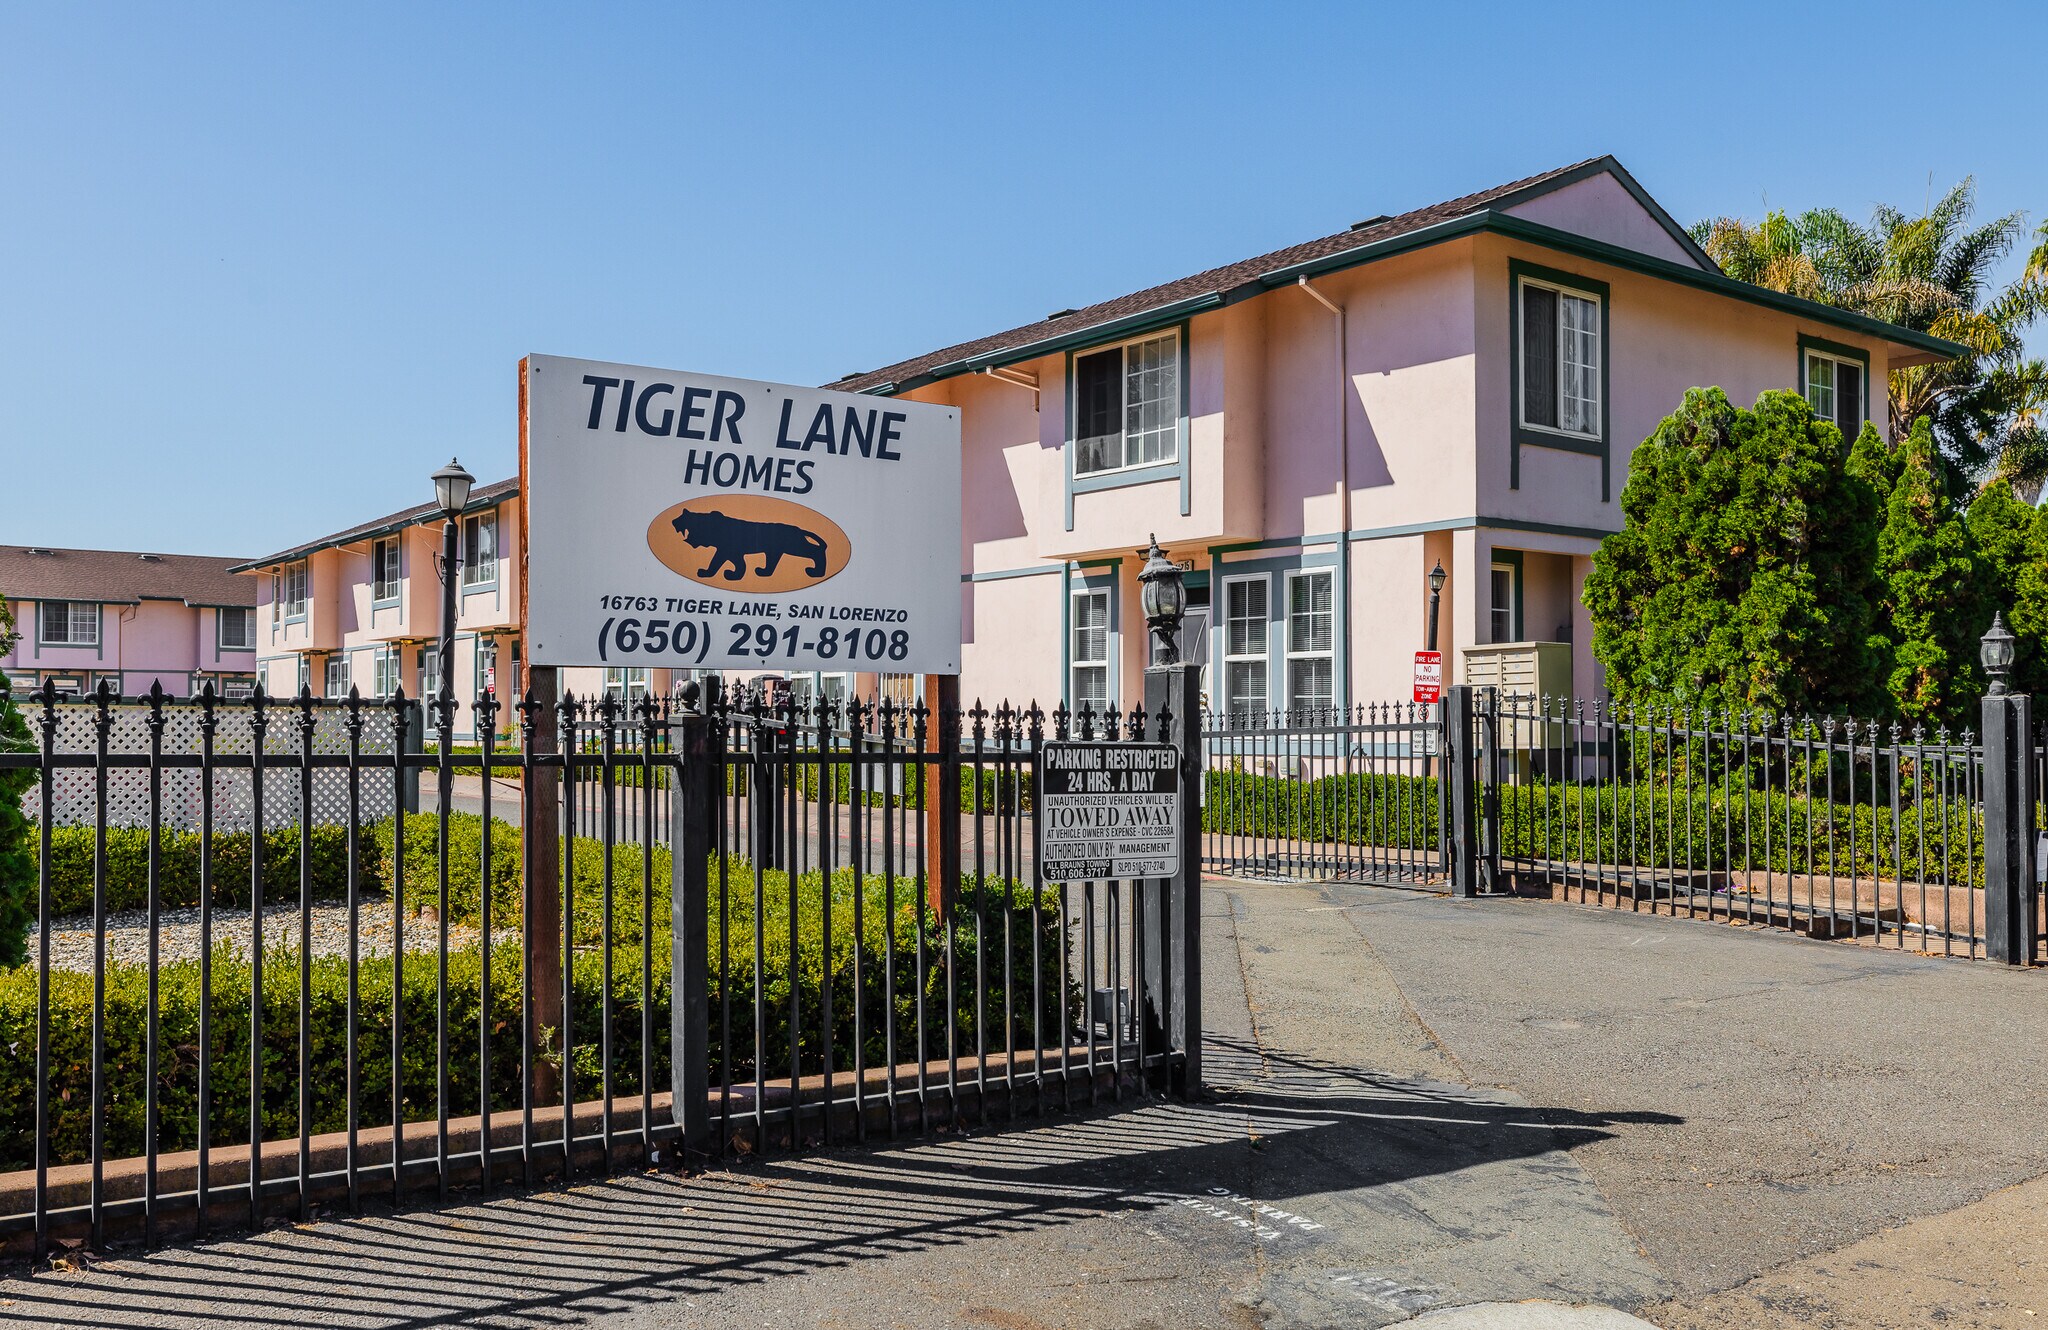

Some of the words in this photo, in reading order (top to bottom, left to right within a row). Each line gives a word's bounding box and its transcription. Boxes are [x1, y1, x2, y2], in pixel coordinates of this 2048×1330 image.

[582, 375, 746, 444] TIGER
[776, 398, 907, 462] LANE
[683, 449, 816, 495] HOMES
[600, 595, 659, 612] 16763
[665, 598, 723, 615] TIGER
[728, 601, 782, 621] LANE,
[788, 604, 825, 620] SAN
[829, 606, 908, 623] LORENZO
[598, 617, 712, 664] (650)
[727, 622, 910, 662] 291-8108
[1415, 674, 1440, 683] PARKING
[1423, 665, 1432, 673] NO
[1046, 748, 1102, 770] PARKING
[1105, 748, 1176, 770] RESTRICTED
[1067, 771, 1083, 792] 24
[1087, 770, 1115, 792] HRS.
[1119, 771, 1128, 791] A
[1132, 771, 1156, 791] DAY
[1048, 795, 1107, 806] UNAUTHORIZED
[1108, 795, 1143, 806] VEHICLES
[1145, 795, 1162, 805] WILL
[1164, 794, 1174, 805] BE
[1047, 807, 1120, 828] TOWED
[1123, 806, 1175, 826] AWAY
[1046, 829, 1055, 839] AT
[1056, 828, 1081, 839] VEHICLE
[1082, 827, 1110, 838] OWNER'S
[1111, 826, 1137, 838] EXPENSE
[1141, 826, 1153, 837] CVC
[1044, 843, 1086, 860] AUTHORIZED
[1087, 842, 1104, 858] ONLY
[1105, 841, 1115, 858] BY:
[1119, 842, 1171, 854] MANAGEMENT
[1046, 862, 1059, 870] ALL
[1086, 859, 1110, 868] TOWING
